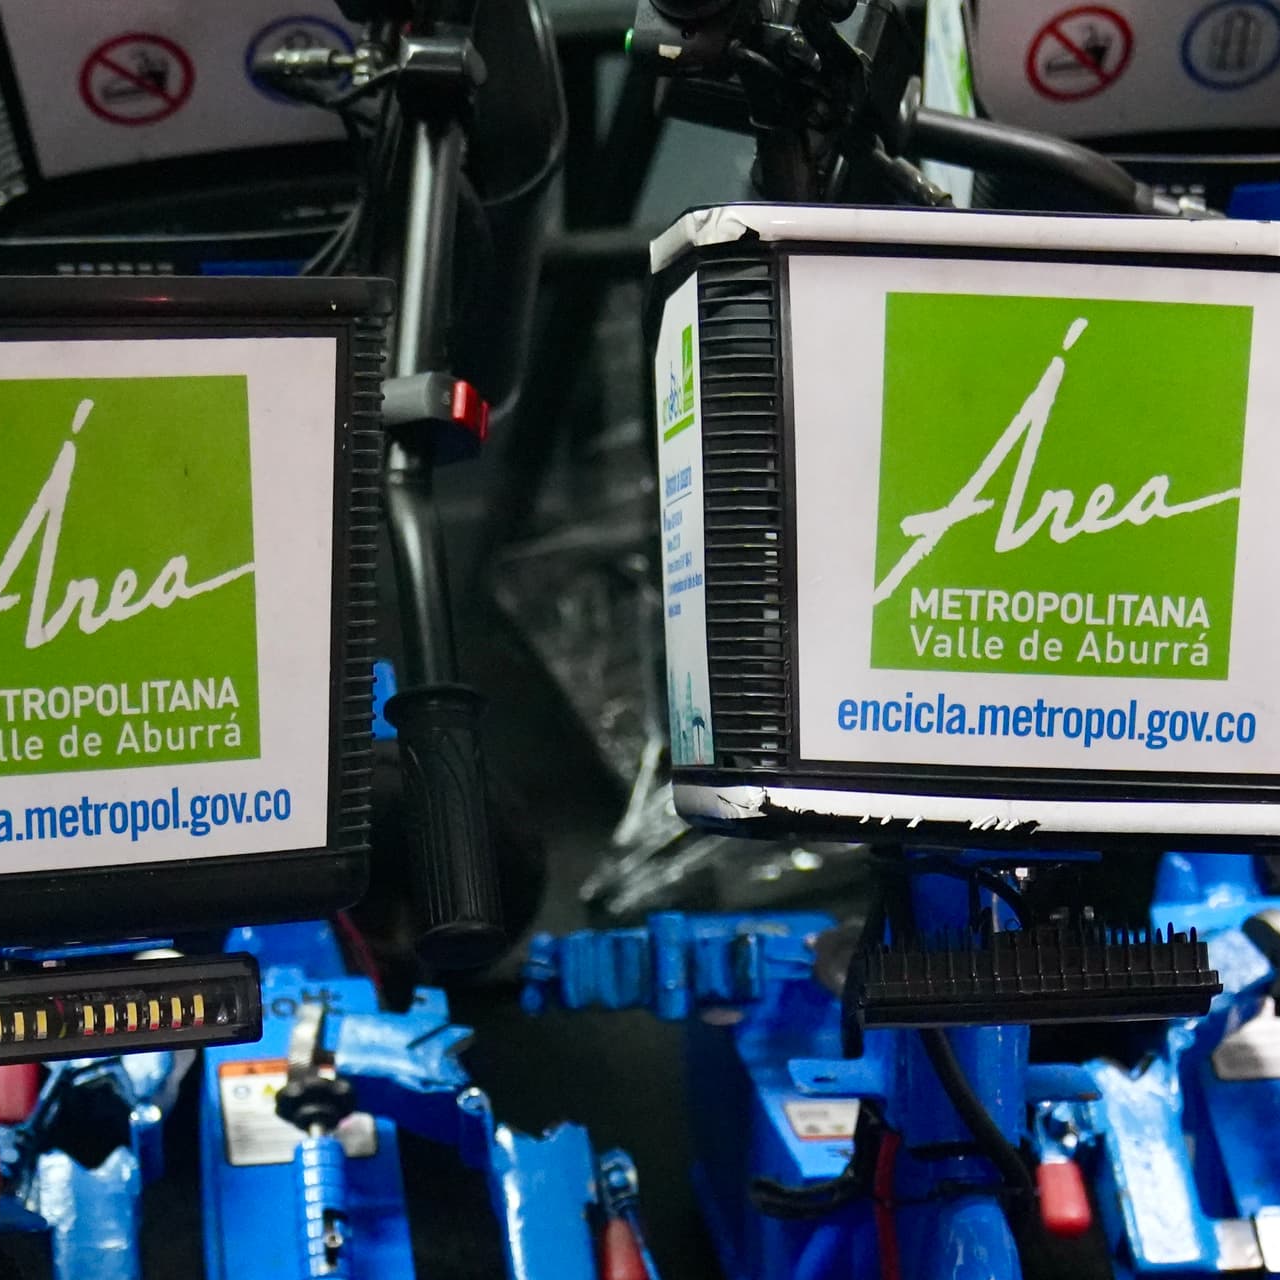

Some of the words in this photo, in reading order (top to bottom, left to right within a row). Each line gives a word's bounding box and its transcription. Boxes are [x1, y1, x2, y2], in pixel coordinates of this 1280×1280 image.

[873, 317, 1241, 606] Área
[909, 586, 1211, 630] METROPOLITANA
[909, 623, 1004, 660] Valle
[1019, 629, 1064, 662] de
[1076, 631, 1210, 667] Aburrá
[58, 724, 102, 759] de
[116, 710, 242, 757] Aburrá
[837, 691, 1258, 750] encicla.metropol.gov.co
